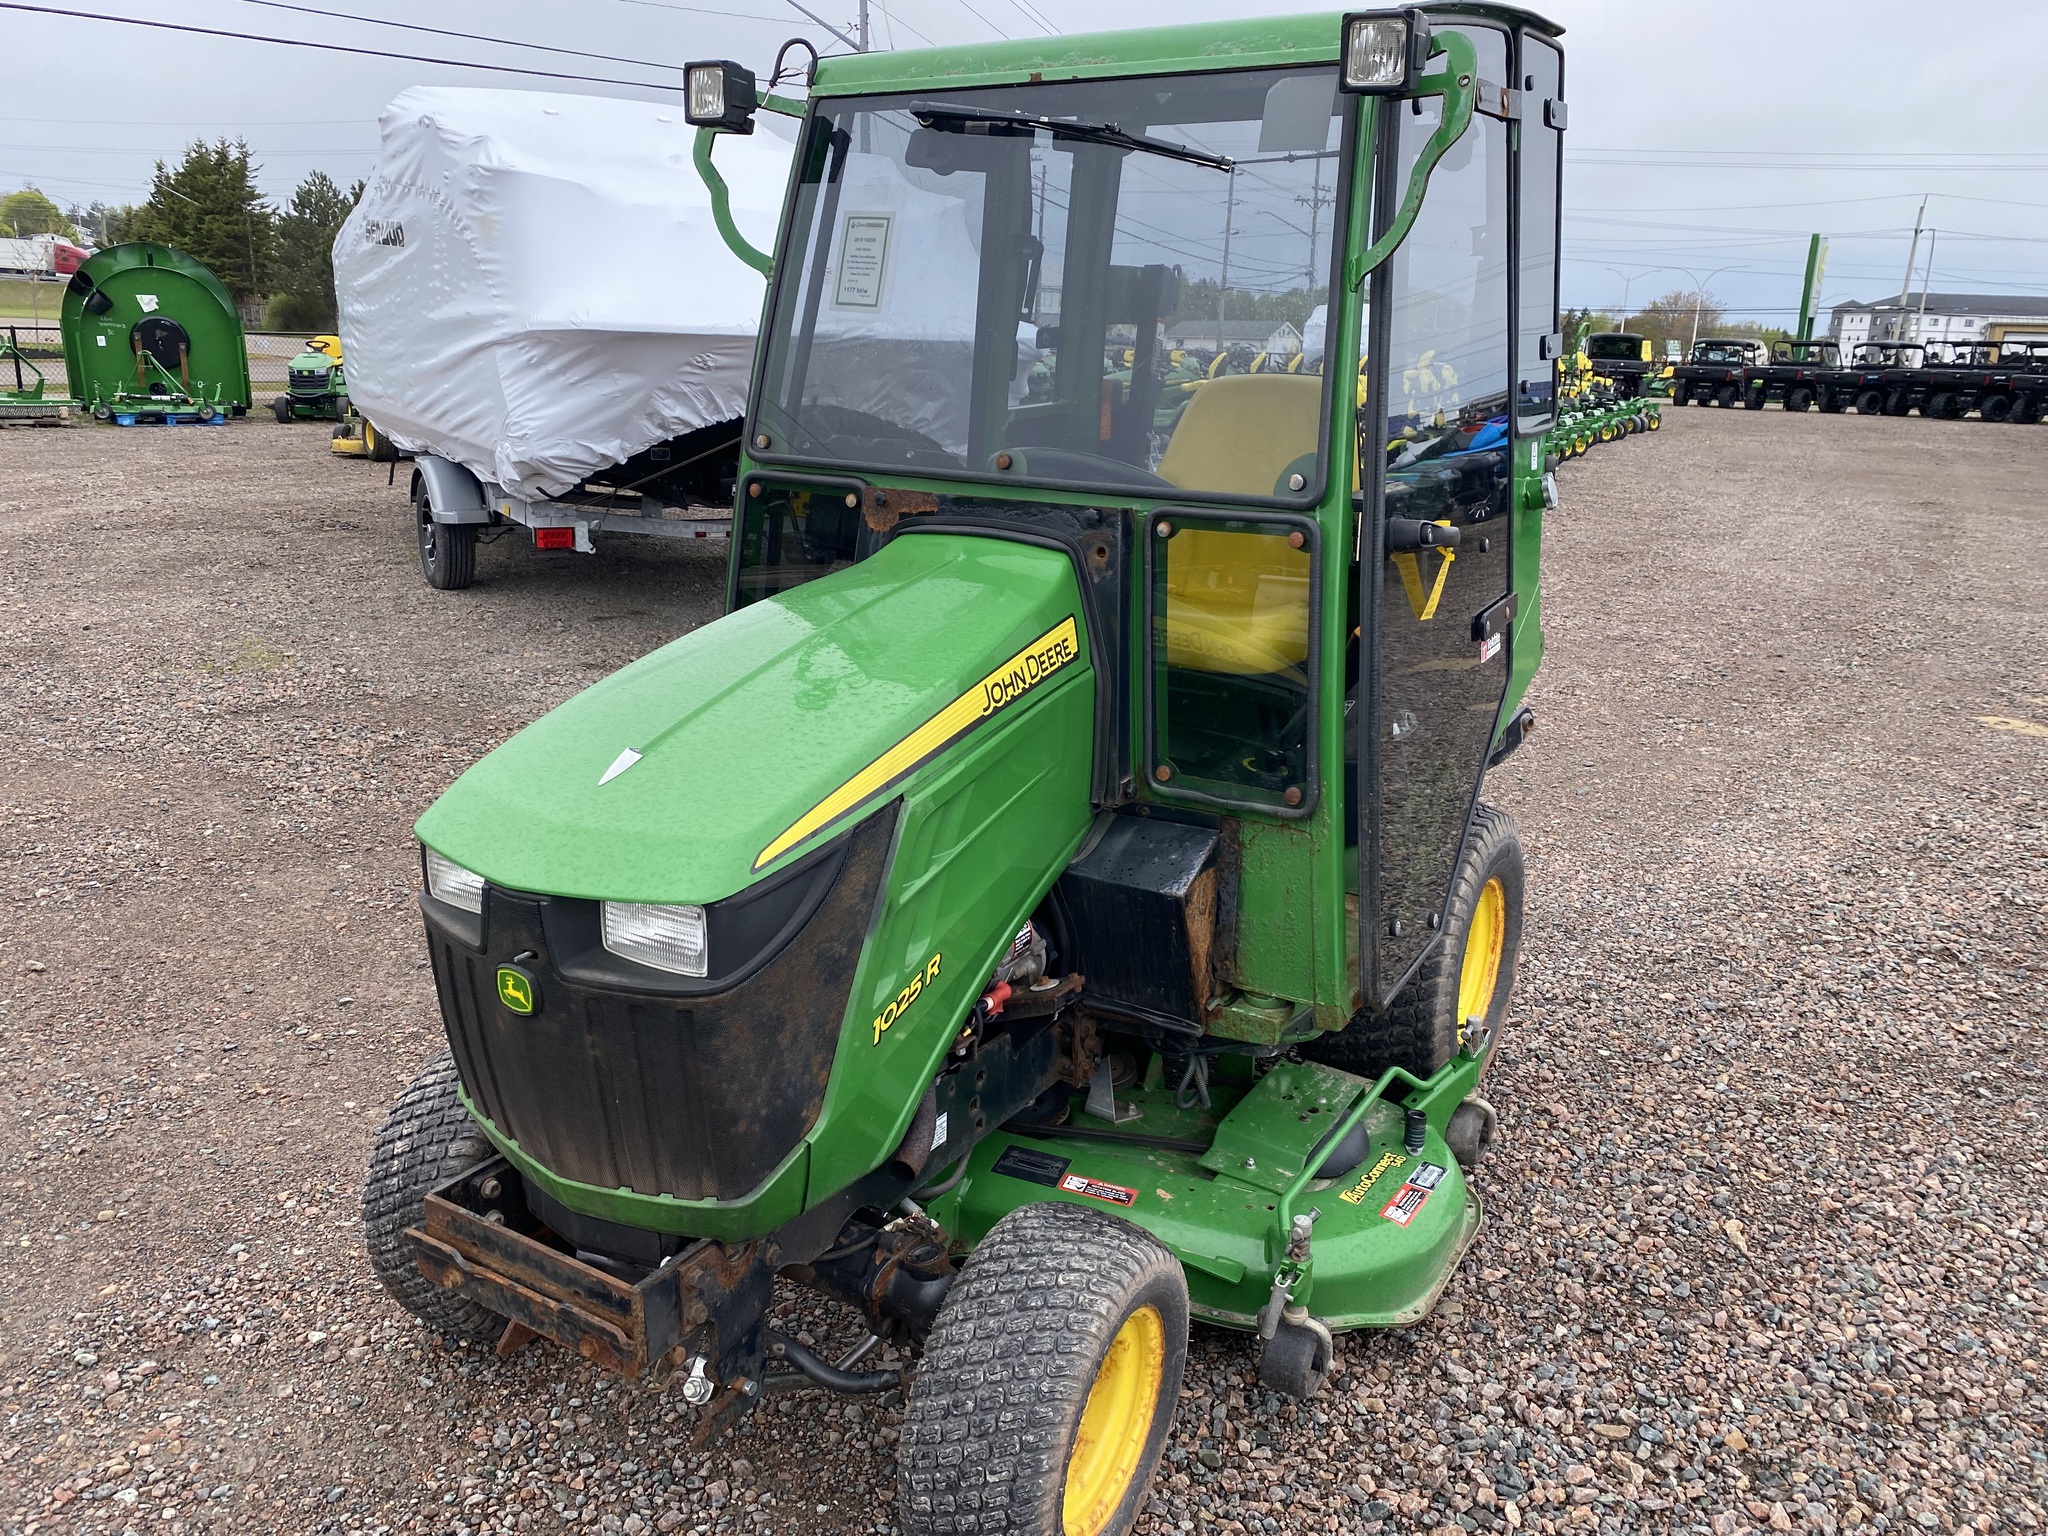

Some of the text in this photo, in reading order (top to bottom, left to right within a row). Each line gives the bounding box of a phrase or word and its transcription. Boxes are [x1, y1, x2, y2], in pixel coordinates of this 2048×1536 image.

[982, 637, 1073, 713] JOHN DEERE
[1347, 1151, 1398, 1204] AutoConnect
